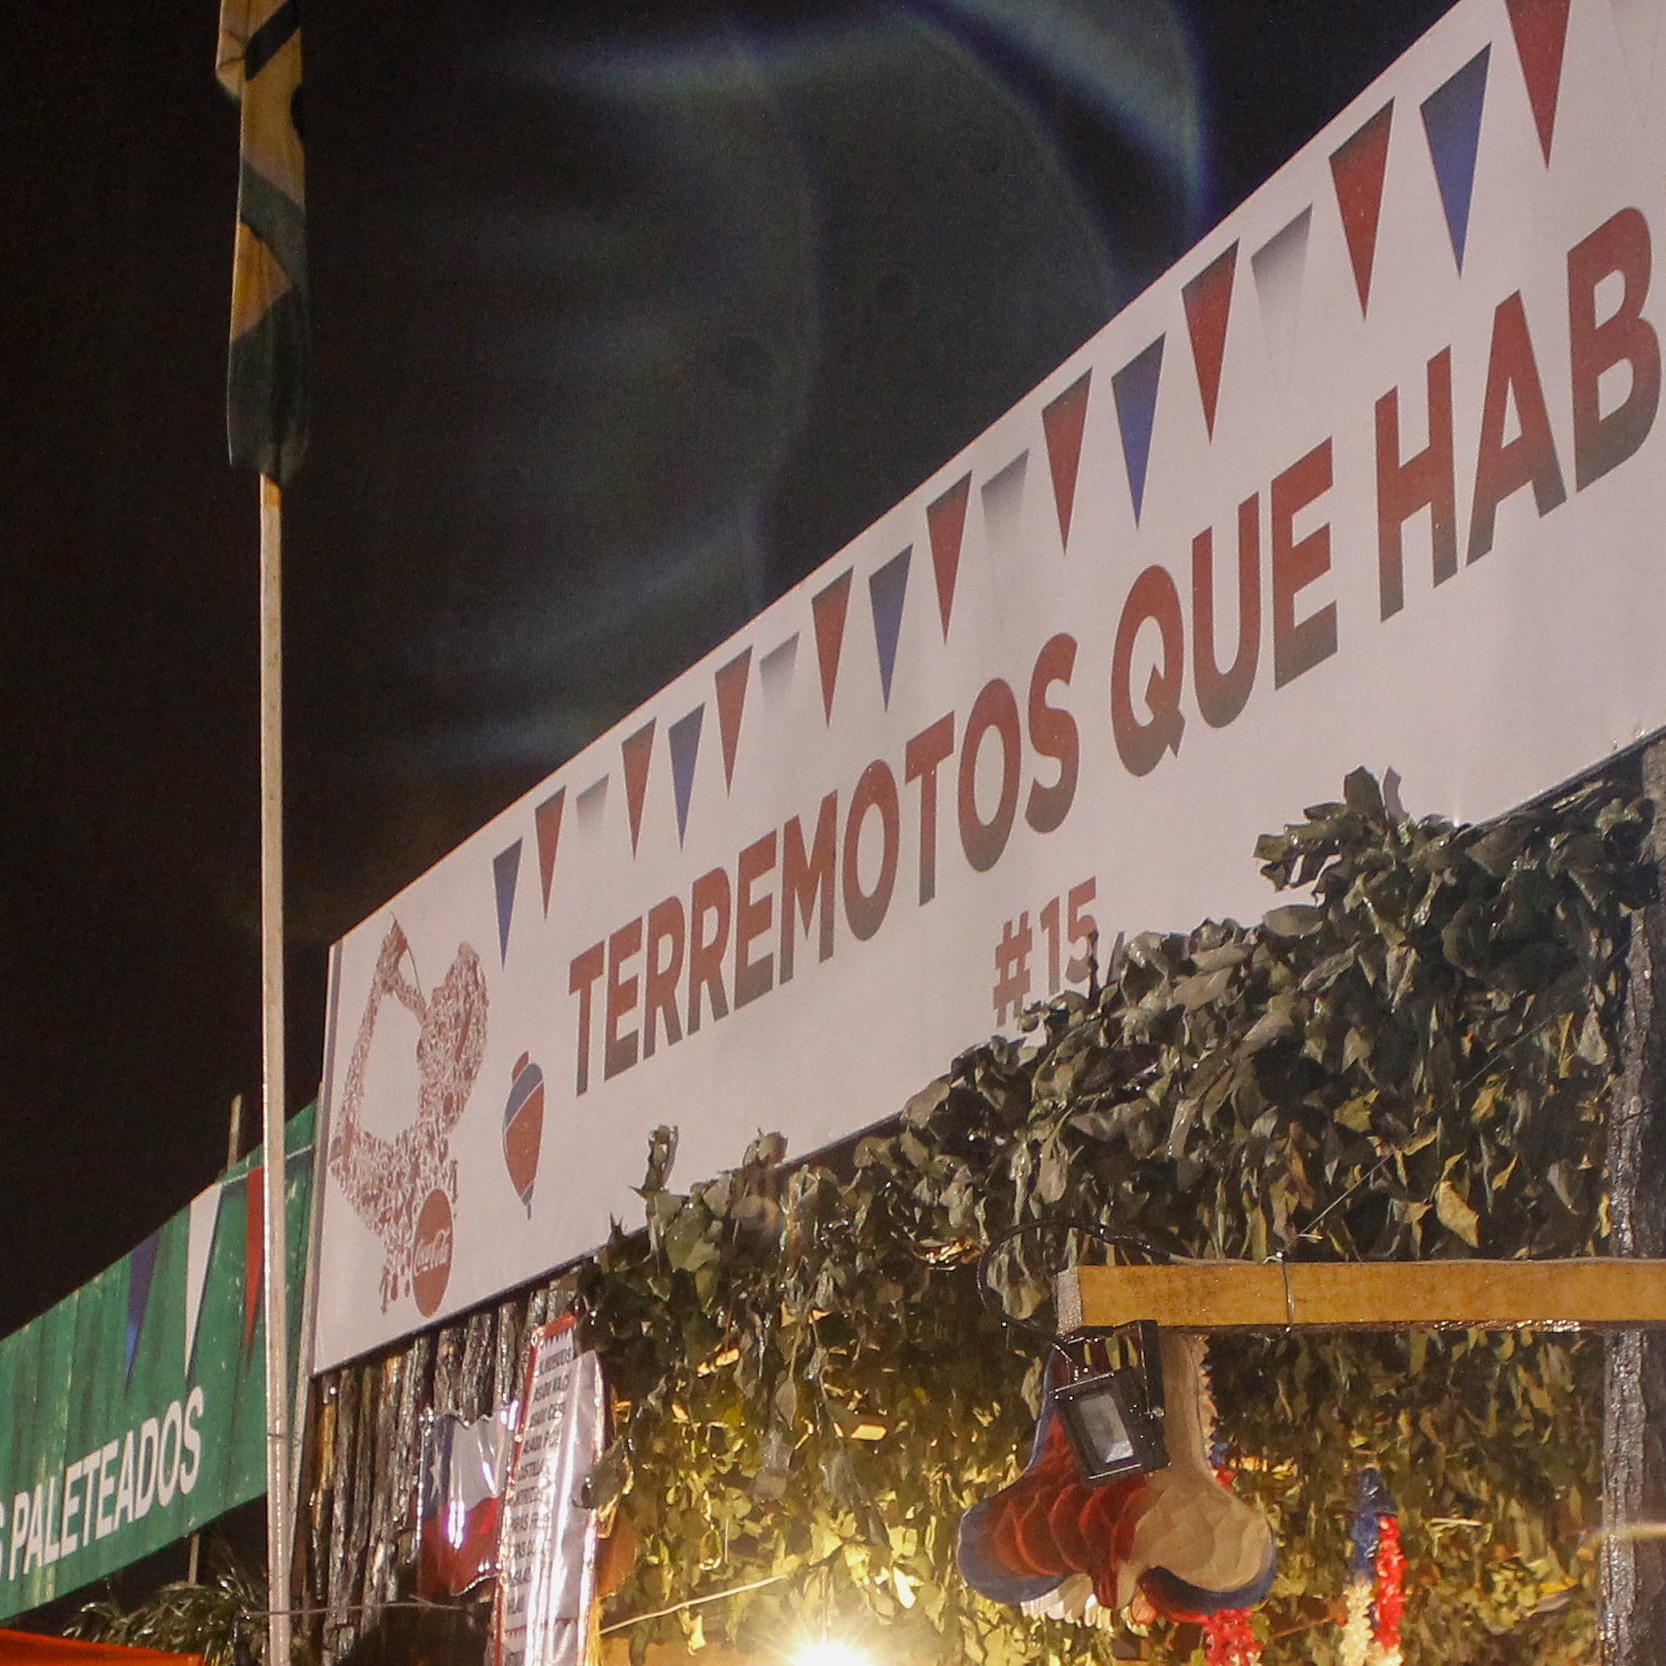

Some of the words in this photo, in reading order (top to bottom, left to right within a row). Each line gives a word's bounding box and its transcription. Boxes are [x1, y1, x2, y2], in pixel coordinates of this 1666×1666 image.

[569, 632, 1080, 1097] TERREMOTOS
[1111, 436, 1338, 777] QUE
[8, 1386, 205, 1582] PALETEADOS
